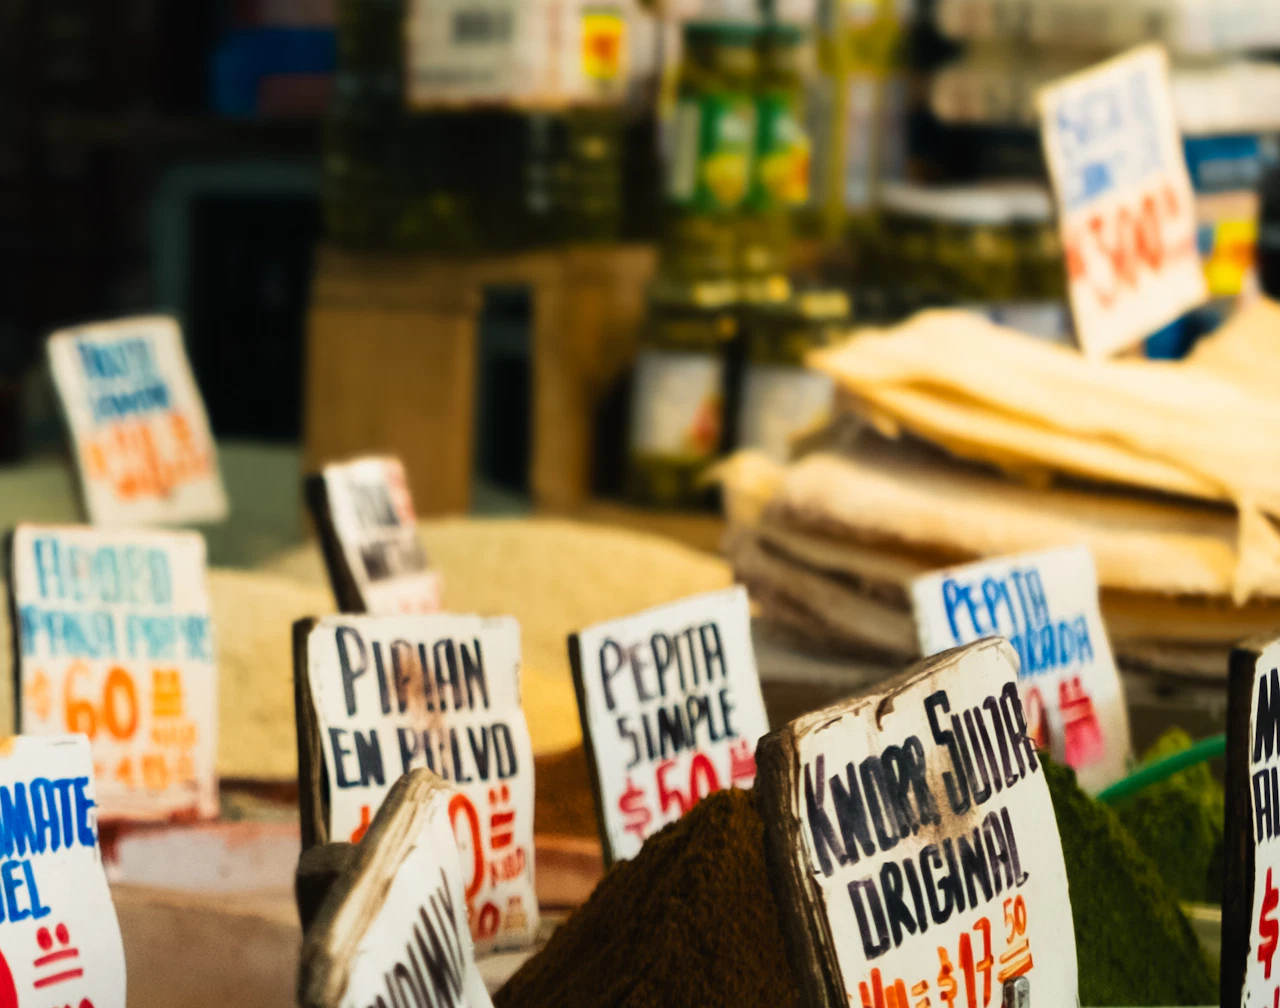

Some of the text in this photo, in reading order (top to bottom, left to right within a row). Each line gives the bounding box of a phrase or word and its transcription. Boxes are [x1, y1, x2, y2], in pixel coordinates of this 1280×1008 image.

[943, 568, 1050, 648] PEPITA
[335, 625, 490, 717] PIPIAN
[599, 621, 727, 711] PEPITA
[328, 726, 386, 789] EN
[616, 689, 740, 770] SIMPLE
[803, 734, 939, 879] KNORR
[847, 806, 1029, 960] ORIGINAL
